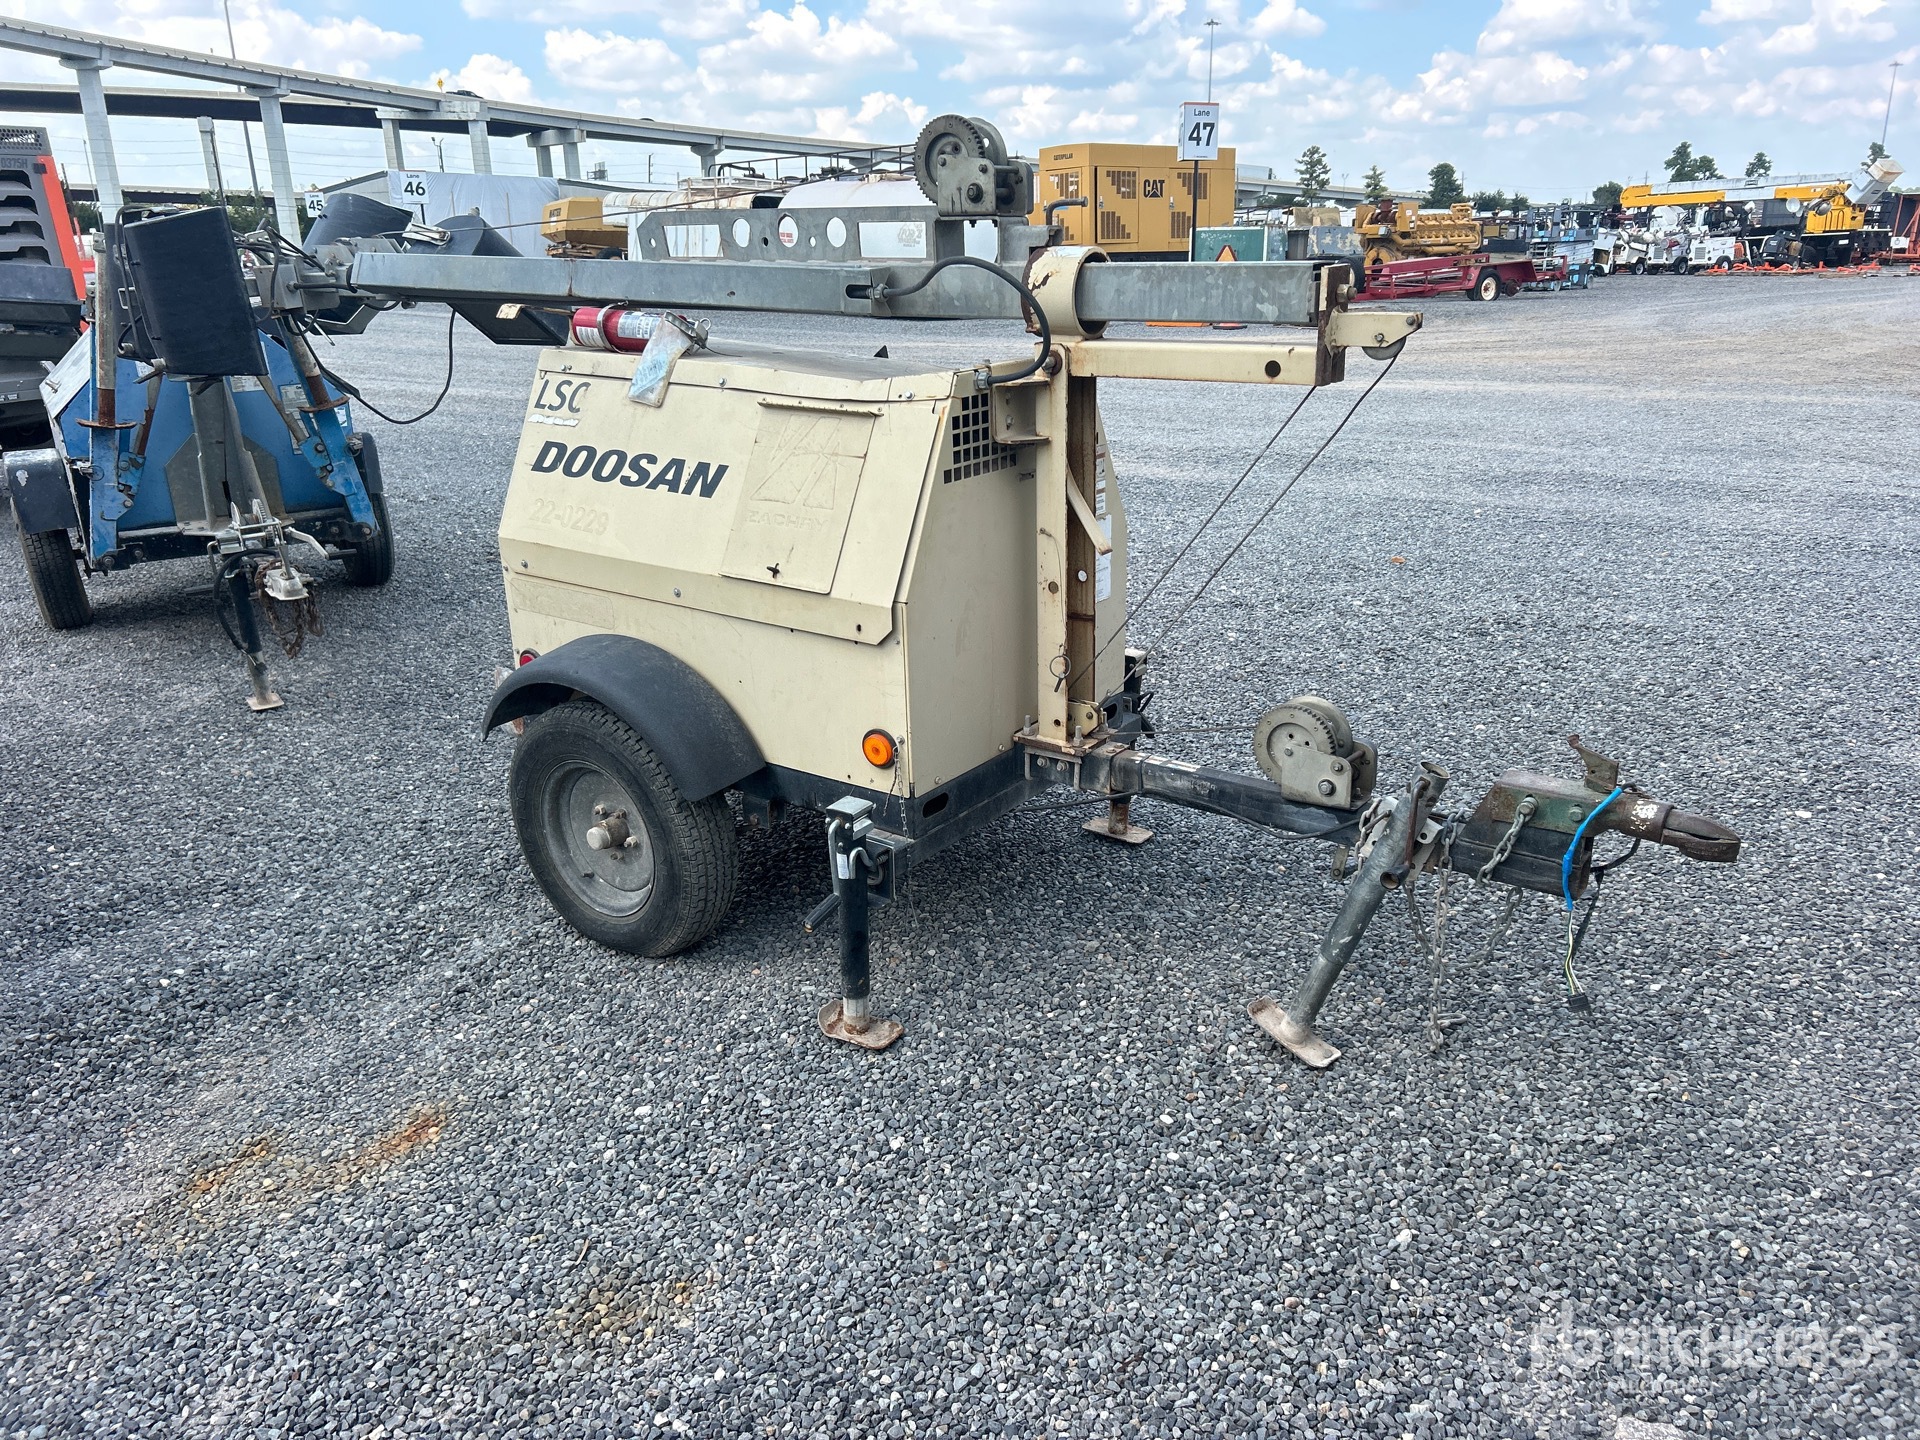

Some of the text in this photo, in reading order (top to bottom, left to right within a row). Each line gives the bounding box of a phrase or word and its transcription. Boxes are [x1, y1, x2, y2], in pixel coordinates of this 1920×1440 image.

[1193, 108, 1211, 117] Lane
[1187, 121, 1216, 147] 47
[403, 181, 426, 196] 46
[1143, 179, 1166, 198] CAT
[308, 200, 324, 211] 45
[533, 378, 592, 414] LSC
[530, 440, 730, 499] DOOSAN
